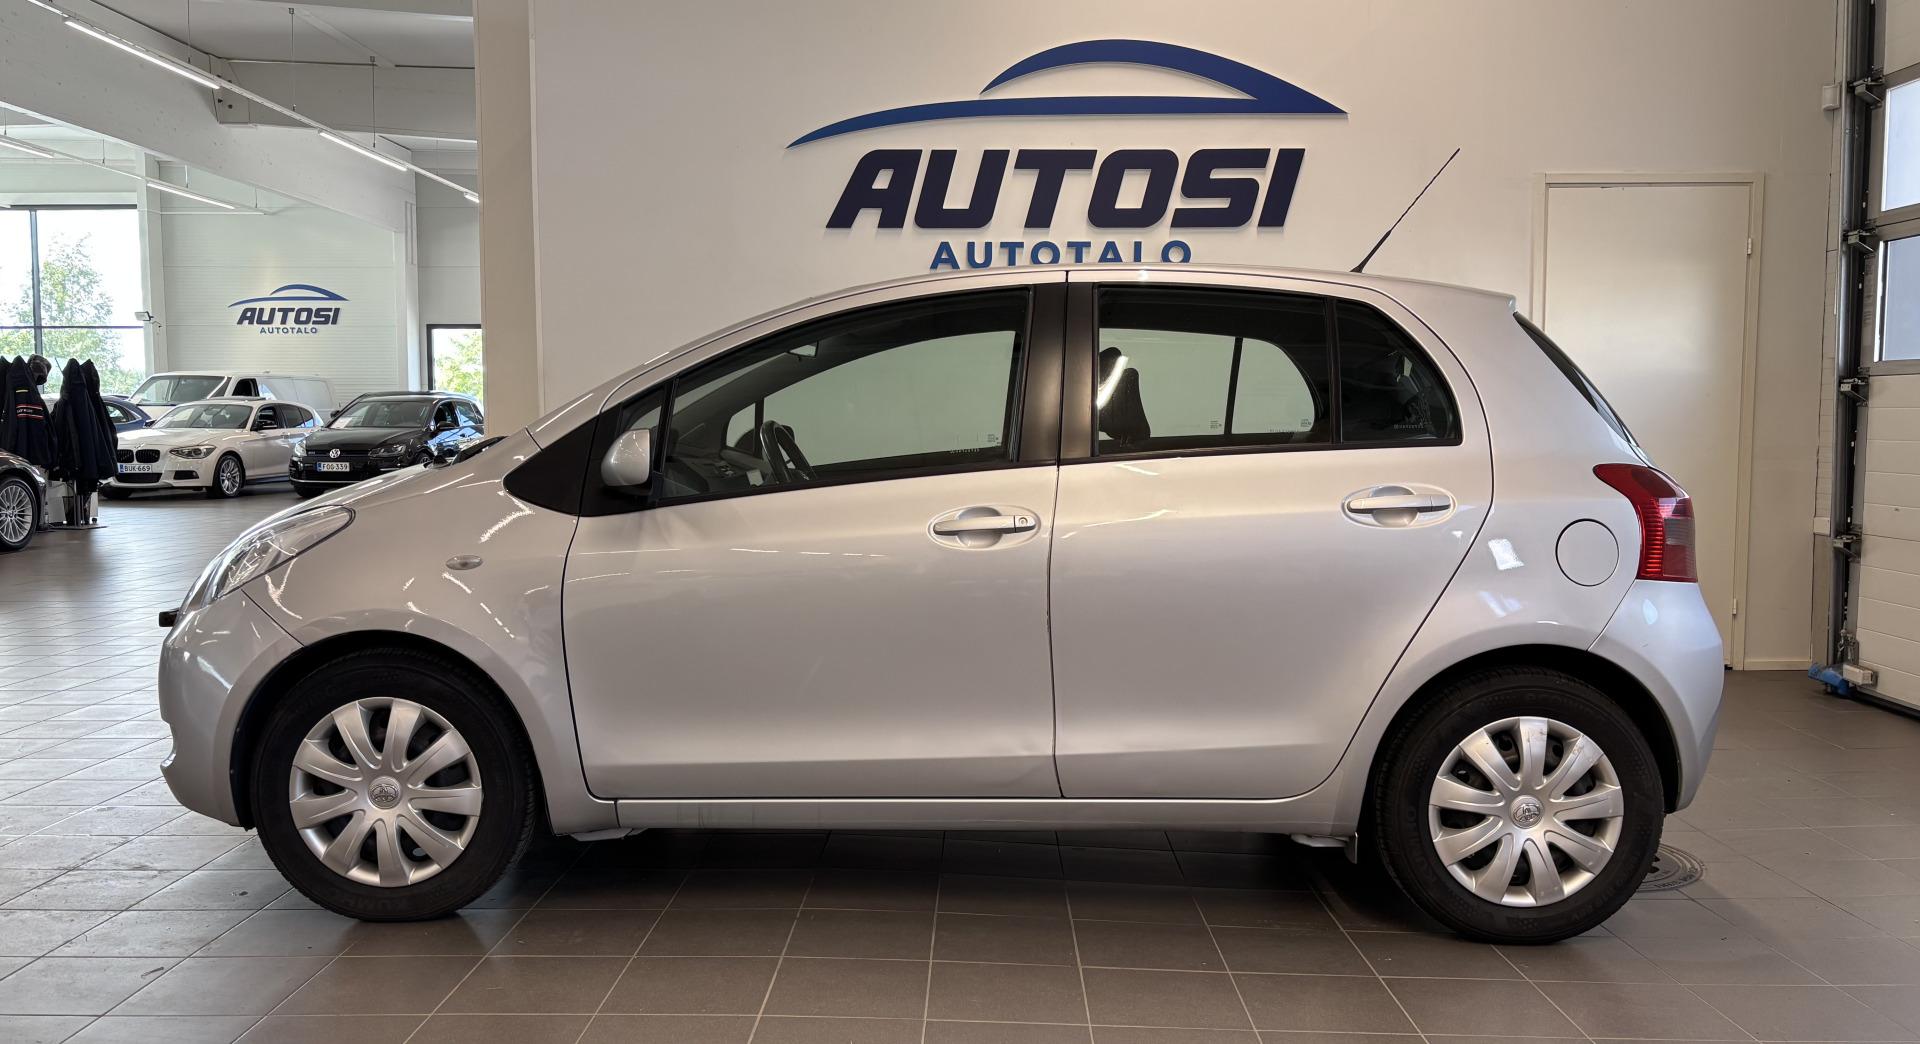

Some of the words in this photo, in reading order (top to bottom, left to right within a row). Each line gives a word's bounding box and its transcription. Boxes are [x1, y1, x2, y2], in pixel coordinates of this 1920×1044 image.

[825, 147, 1306, 229] AUTOSI
[236, 307, 341, 326] AUTOSI
[259, 326, 319, 335] AUTOTALO
